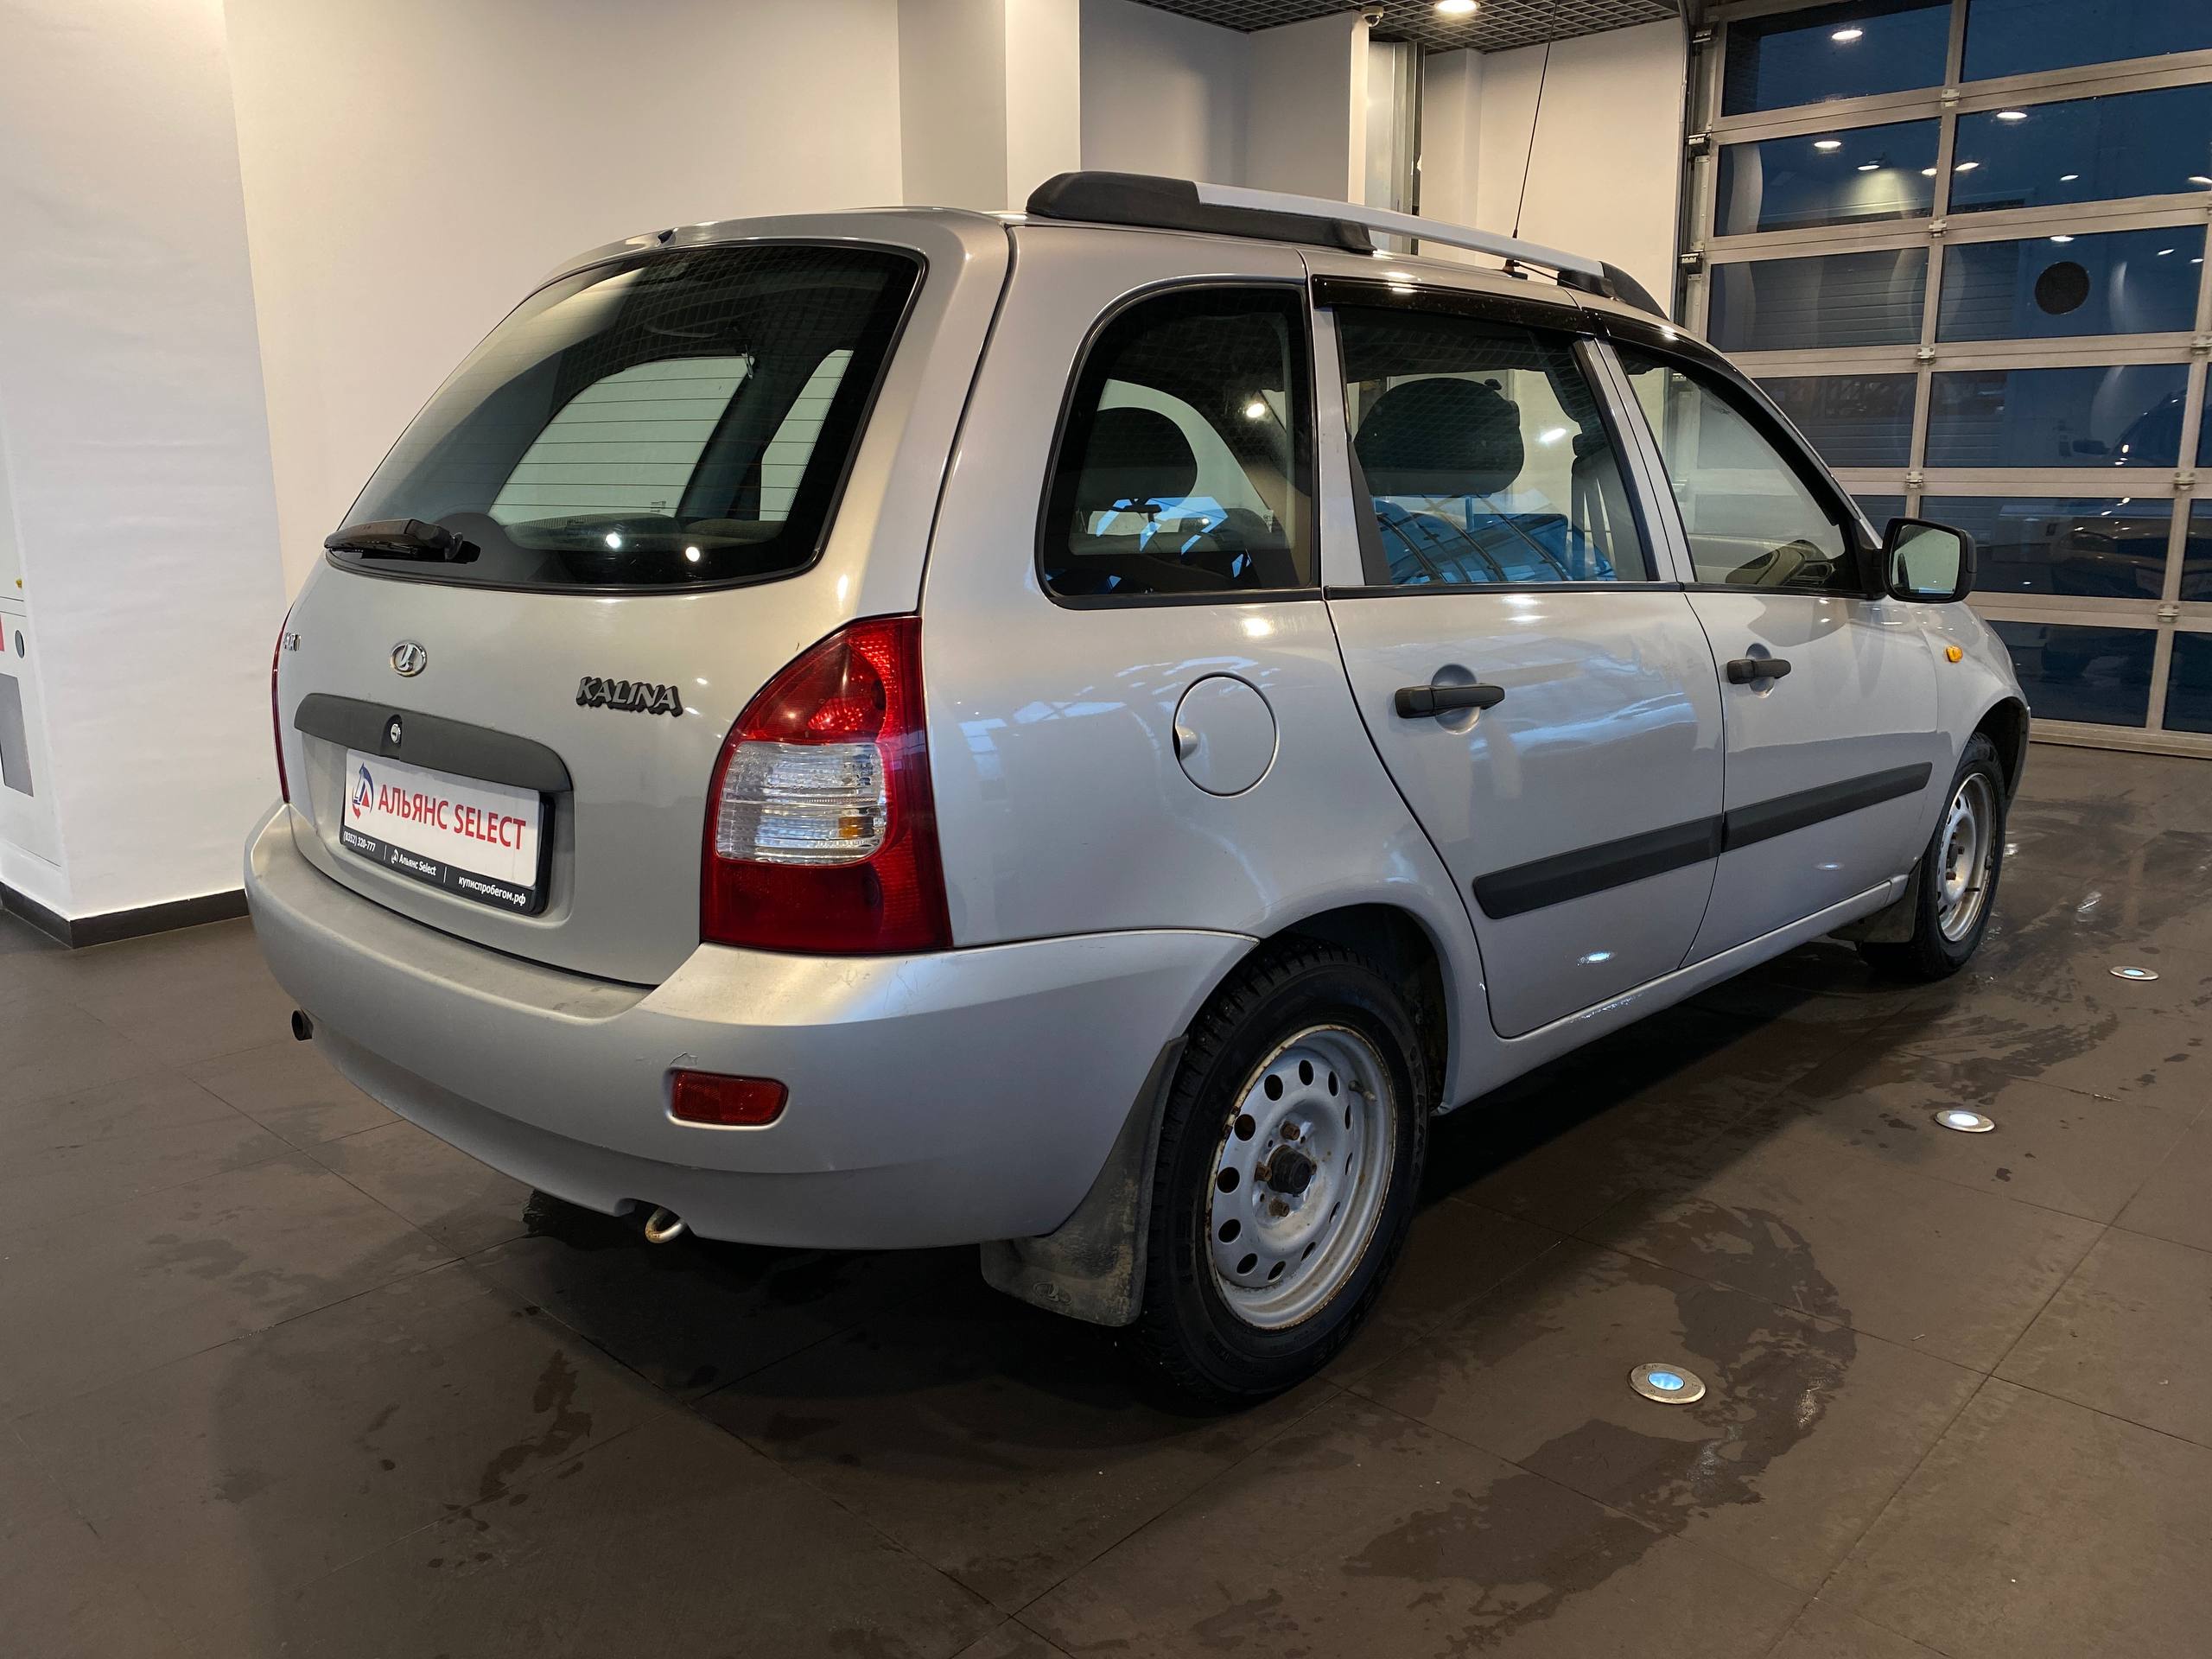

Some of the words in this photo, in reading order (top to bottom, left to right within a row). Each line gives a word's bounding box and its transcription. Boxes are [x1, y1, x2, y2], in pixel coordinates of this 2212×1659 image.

[576, 677, 683, 717] KALINA
[378, 784, 448, 830] АЛЬЯНС
[454, 804, 526, 850] SELECT
[343, 830, 358, 847] (8352)
[357, 836, 376, 853] 320-777
[398, 853, 418, 869] Альянс
[418, 861, 436, 876] Select
[458, 876, 526, 906] куписпробегом.рф
